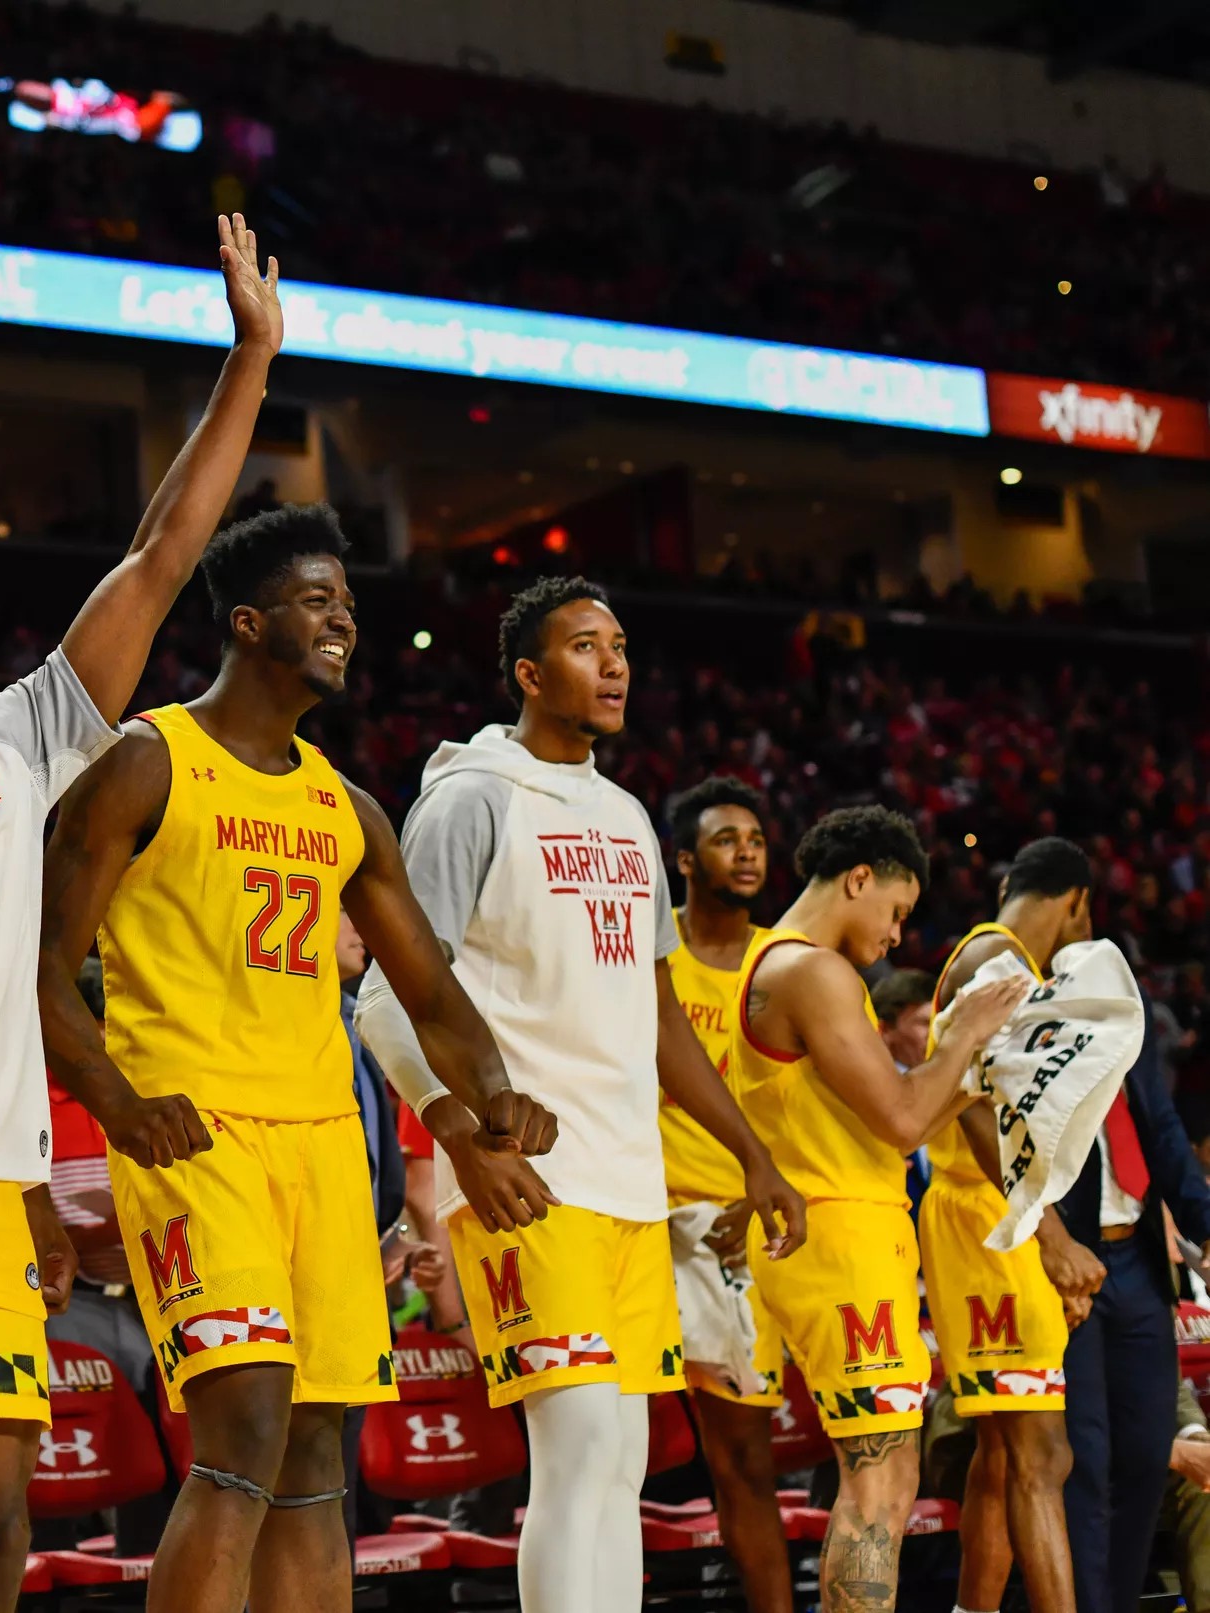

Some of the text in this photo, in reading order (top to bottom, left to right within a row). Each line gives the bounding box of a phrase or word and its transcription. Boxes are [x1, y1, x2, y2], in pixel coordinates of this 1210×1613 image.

[1038, 382, 1163, 453] xfinity
[215, 814, 339, 867] MARYLAND
[541, 845, 650, 885] MARYLAND
[243, 866, 322, 980] 22
[140, 1214, 201, 1303] M
[480, 1246, 530, 1322] M
[837, 1301, 902, 1364] M
[966, 1294, 1021, 1349] M
